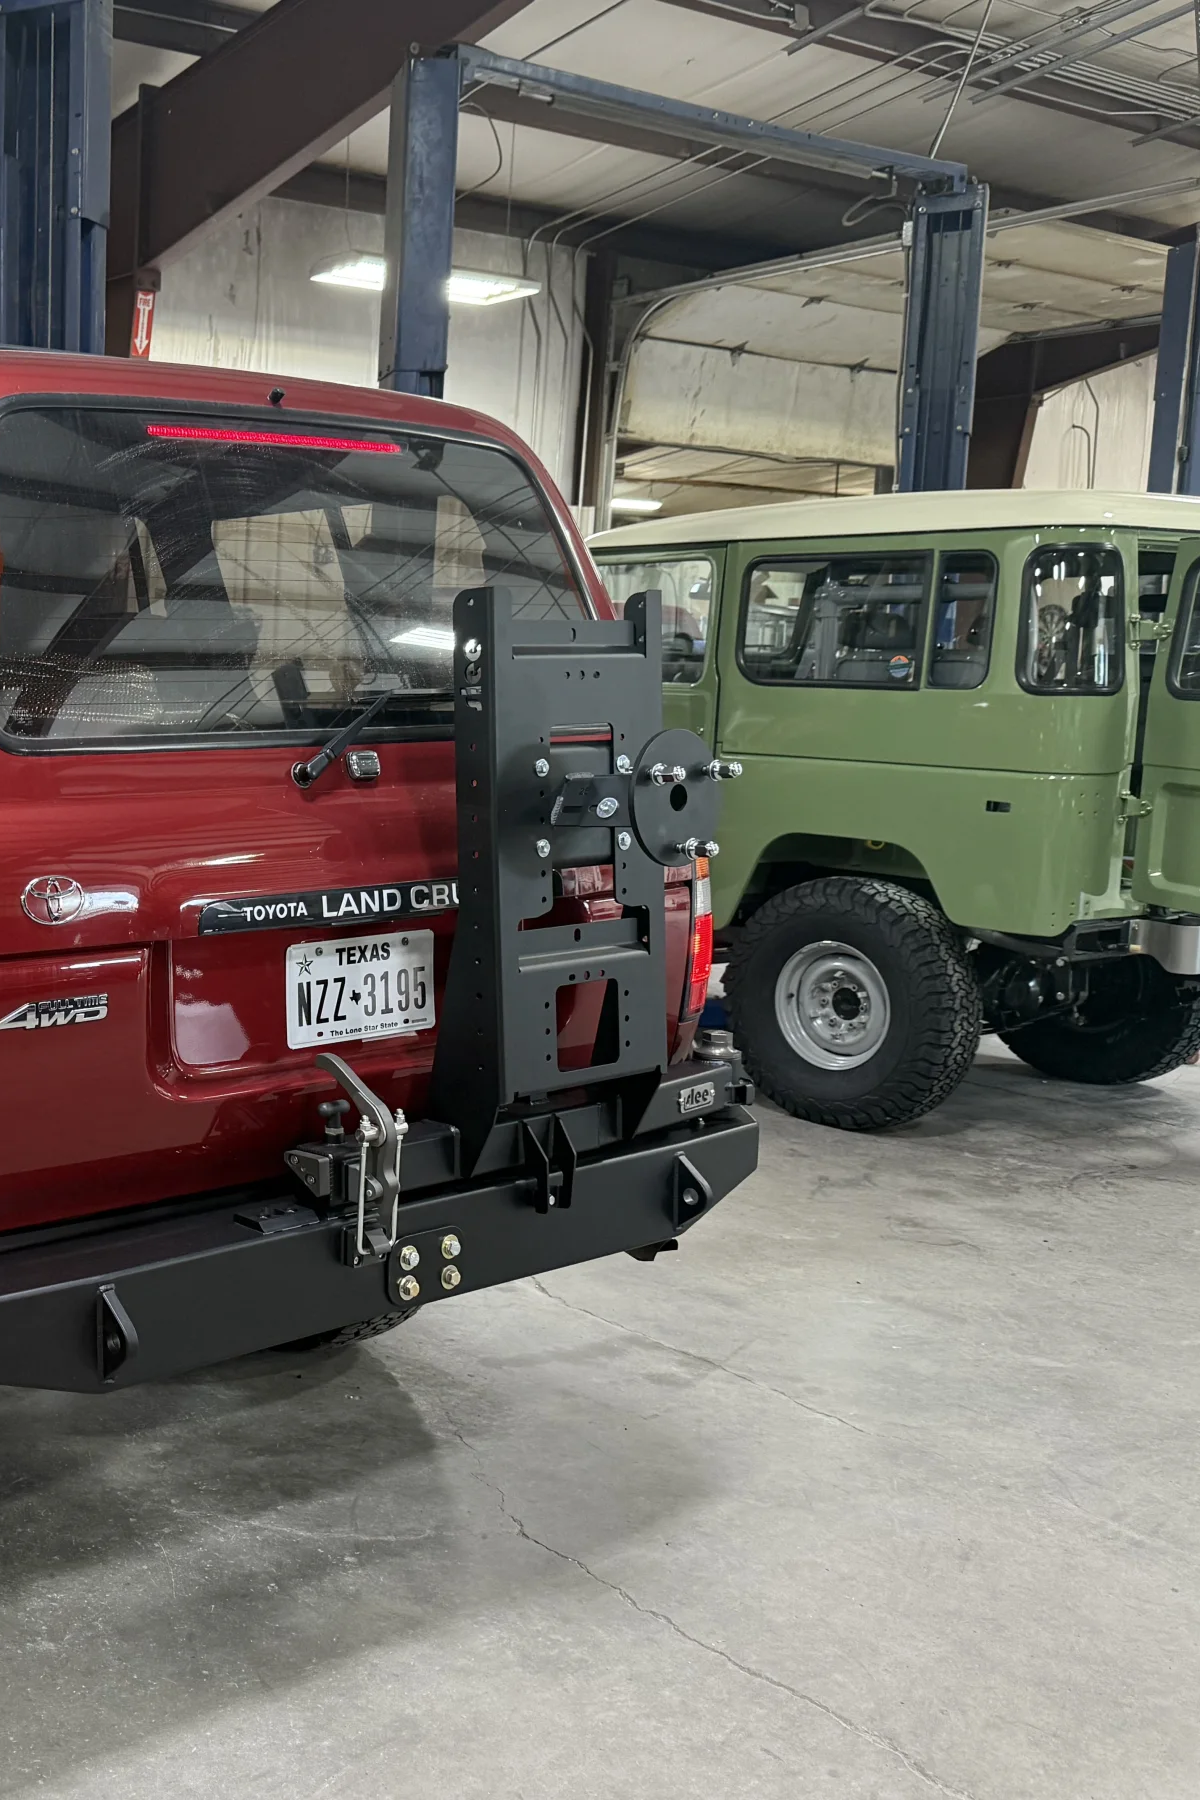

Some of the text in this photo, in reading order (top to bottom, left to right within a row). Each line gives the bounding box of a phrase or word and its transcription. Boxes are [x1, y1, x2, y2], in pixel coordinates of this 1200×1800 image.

[139, 297, 151, 308] FIRE
[243, 902, 308, 922] TOYOTA
[321, 888, 402, 918] LAND
[335, 941, 391, 966] TEXAS
[297, 966, 427, 1027] NZZ 3195
[330, 1020, 398, 1038] The Lone Star State
